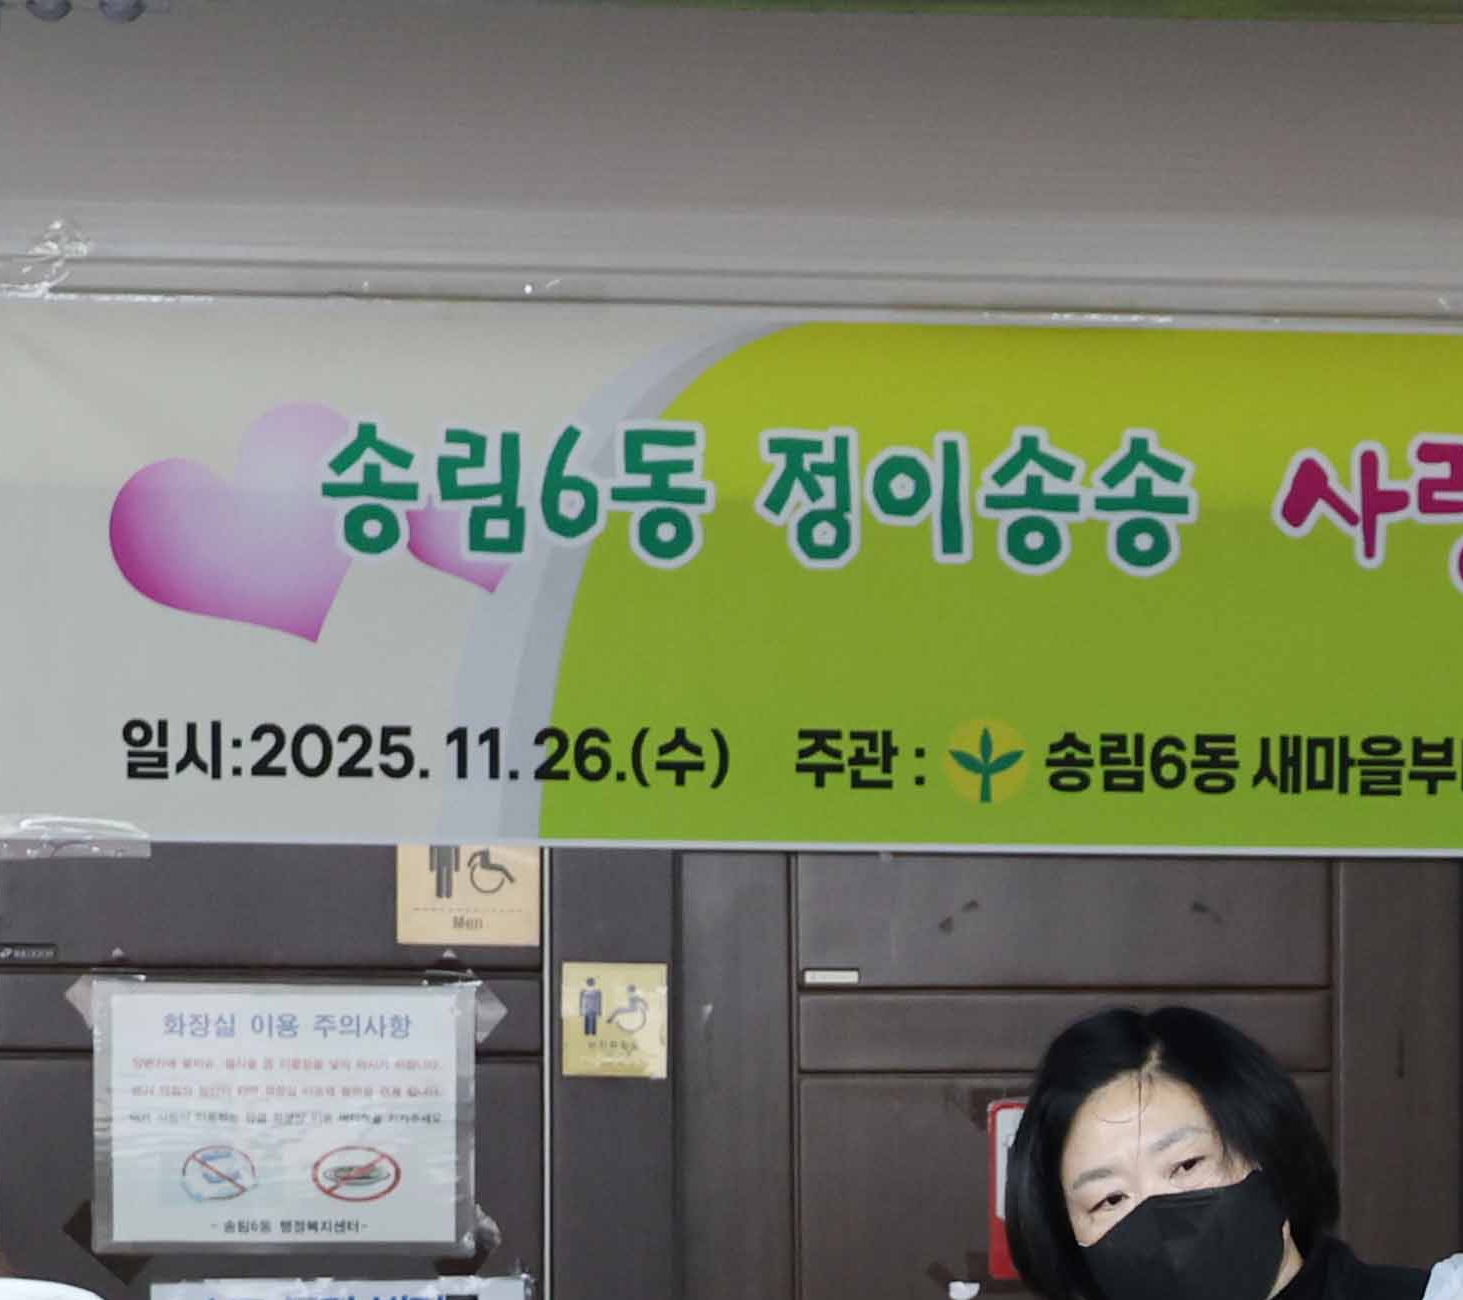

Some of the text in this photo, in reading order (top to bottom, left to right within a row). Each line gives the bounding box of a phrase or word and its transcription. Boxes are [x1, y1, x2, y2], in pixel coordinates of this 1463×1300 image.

[322, 423, 707, 560] 송림6동
[764, 436, 1190, 567] 정이송송
[1045, 732, 1241, 795] 송림6동
[452, 916, 484, 930] Men
[162, 1011, 413, 1041] 화장실 이용 주의사항
